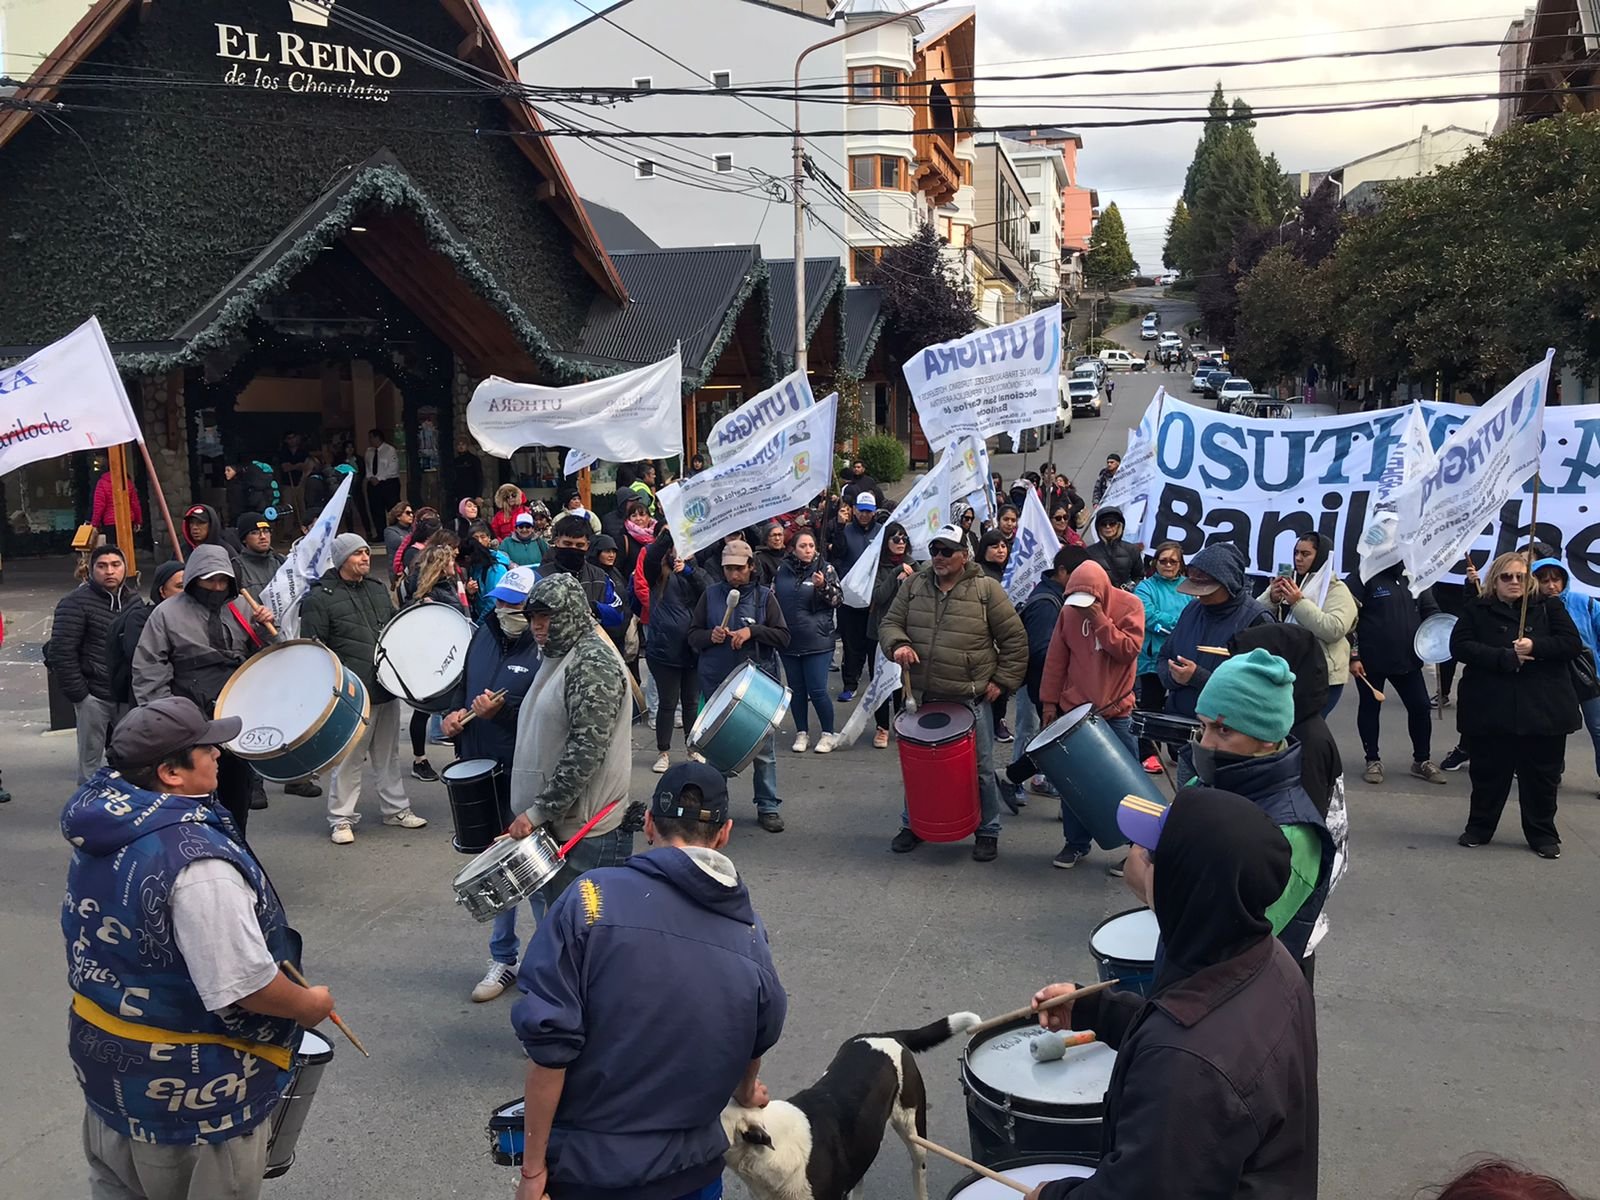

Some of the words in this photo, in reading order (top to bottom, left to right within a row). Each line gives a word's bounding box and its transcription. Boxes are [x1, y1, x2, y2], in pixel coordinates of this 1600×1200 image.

[214, 22, 270, 62] EL
[277, 31, 402, 79] REINO
[224, 63, 248, 86] de
[254, 67, 280, 91] los
[288, 71, 391, 102] Chocolates
